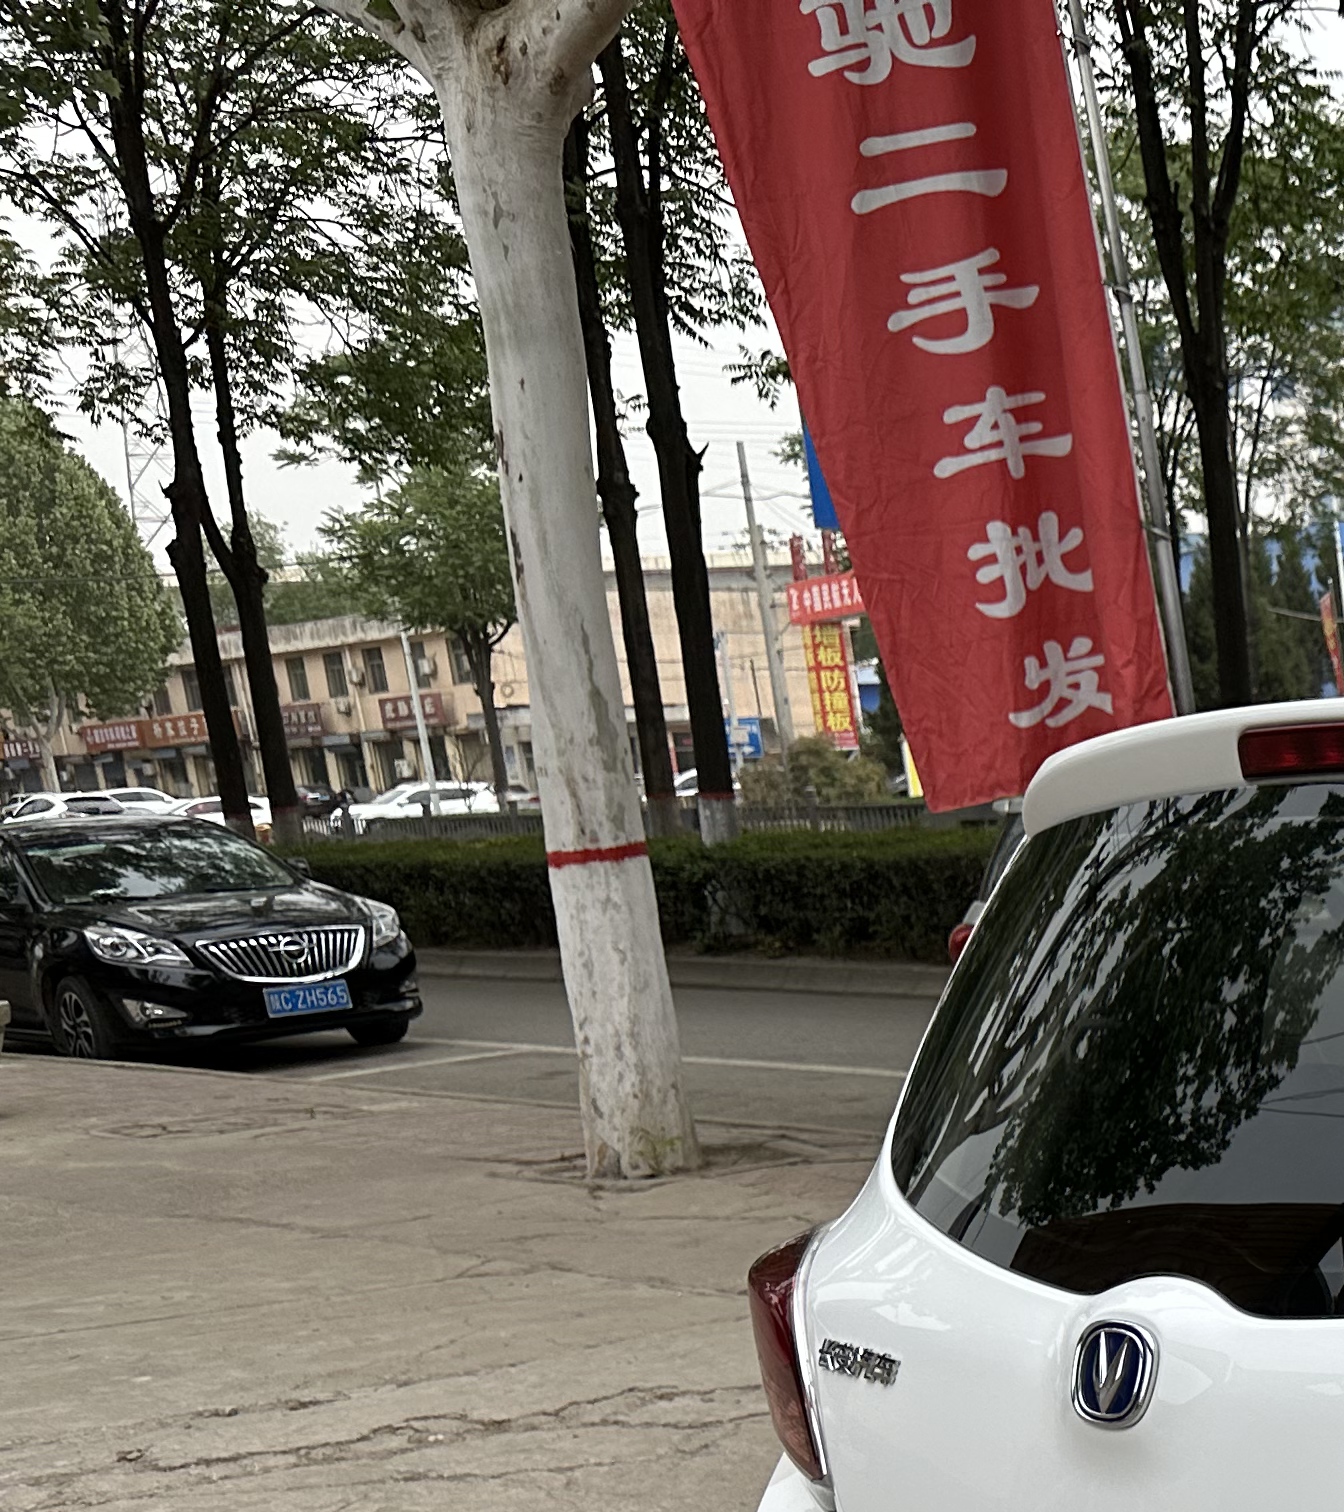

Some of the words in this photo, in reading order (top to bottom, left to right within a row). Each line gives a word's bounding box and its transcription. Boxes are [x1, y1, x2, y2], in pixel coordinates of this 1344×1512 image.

[799, 0, 1113, 730] 驰二手车批发
